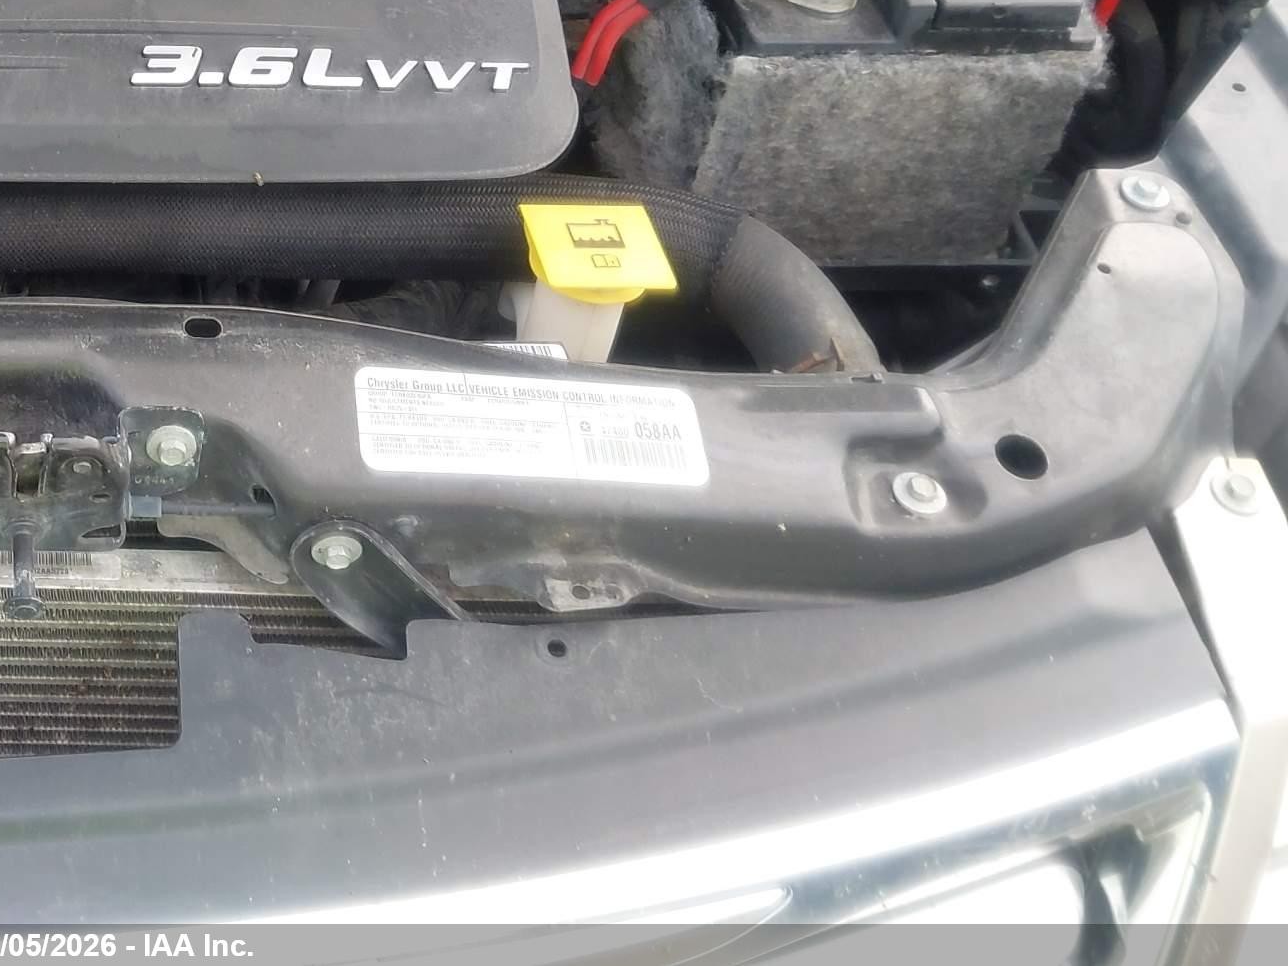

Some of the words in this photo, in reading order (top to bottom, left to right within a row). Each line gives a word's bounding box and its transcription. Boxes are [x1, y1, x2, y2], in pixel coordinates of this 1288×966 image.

[367, 377, 409, 390] Chrysler
[412, 380, 443, 393] Group
[446, 383, 465, 394] LLC
[468, 385, 509, 396] VEHICLE
[512, 387, 559, 400] EMISSION
[562, 391, 605, 403] CONTROL
[609, 394, 676, 408] INFORMATION
[634, 421, 682, 440] 058AA
